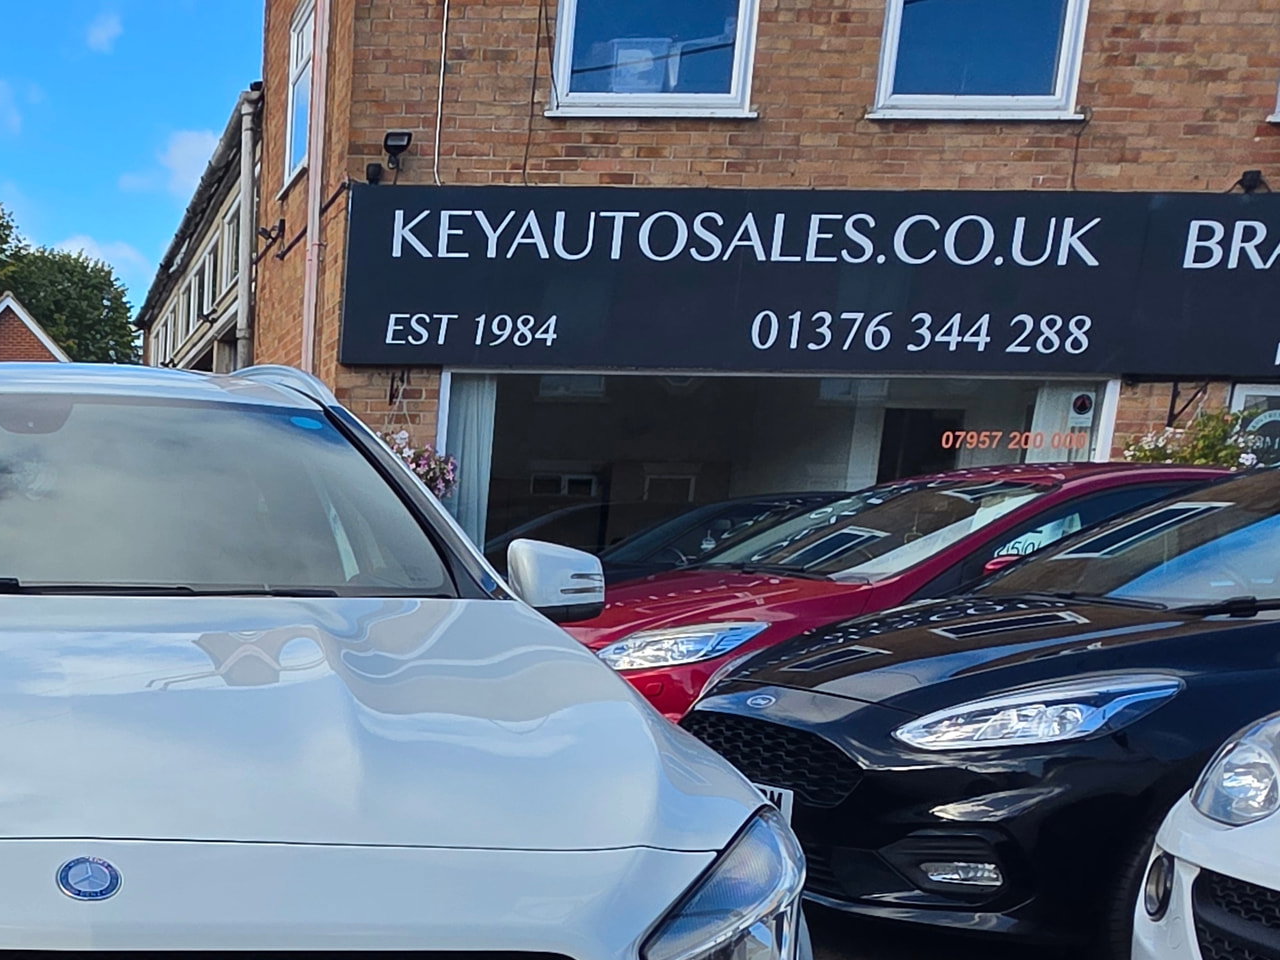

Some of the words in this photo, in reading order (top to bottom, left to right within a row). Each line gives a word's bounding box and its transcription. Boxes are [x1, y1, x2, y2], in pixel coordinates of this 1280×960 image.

[391, 208, 1102, 267] KEYAUTOSALES.CO.UK
[1182, 219, 1280, 270] BR
[385, 313, 459, 345] EST
[474, 313, 558, 347] 1984
[750, 310, 894, 351] 01376
[906, 312, 991, 352] 344
[1005, 313, 1093, 354] 288
[940, 431, 1003, 449] 07957
[1007, 431, 1045, 449] 200
[1050, 431, 1090, 450] 000
